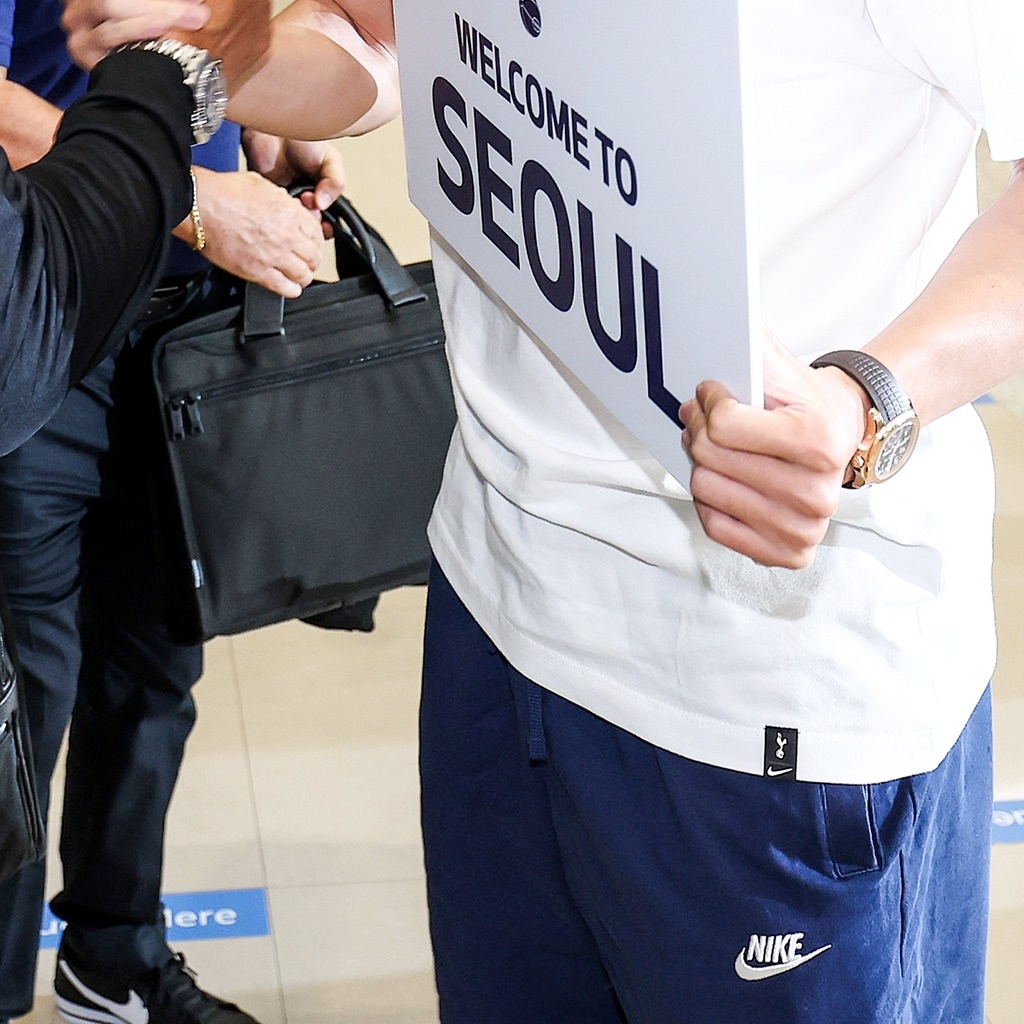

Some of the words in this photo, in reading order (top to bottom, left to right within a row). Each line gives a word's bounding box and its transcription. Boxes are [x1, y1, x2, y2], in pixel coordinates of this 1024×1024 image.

[454, 12, 591, 171] WELCOME
[594, 126, 638, 207] TO
[431, 76, 685, 431] SEOUL
[746, 932, 805, 964] NIKE
